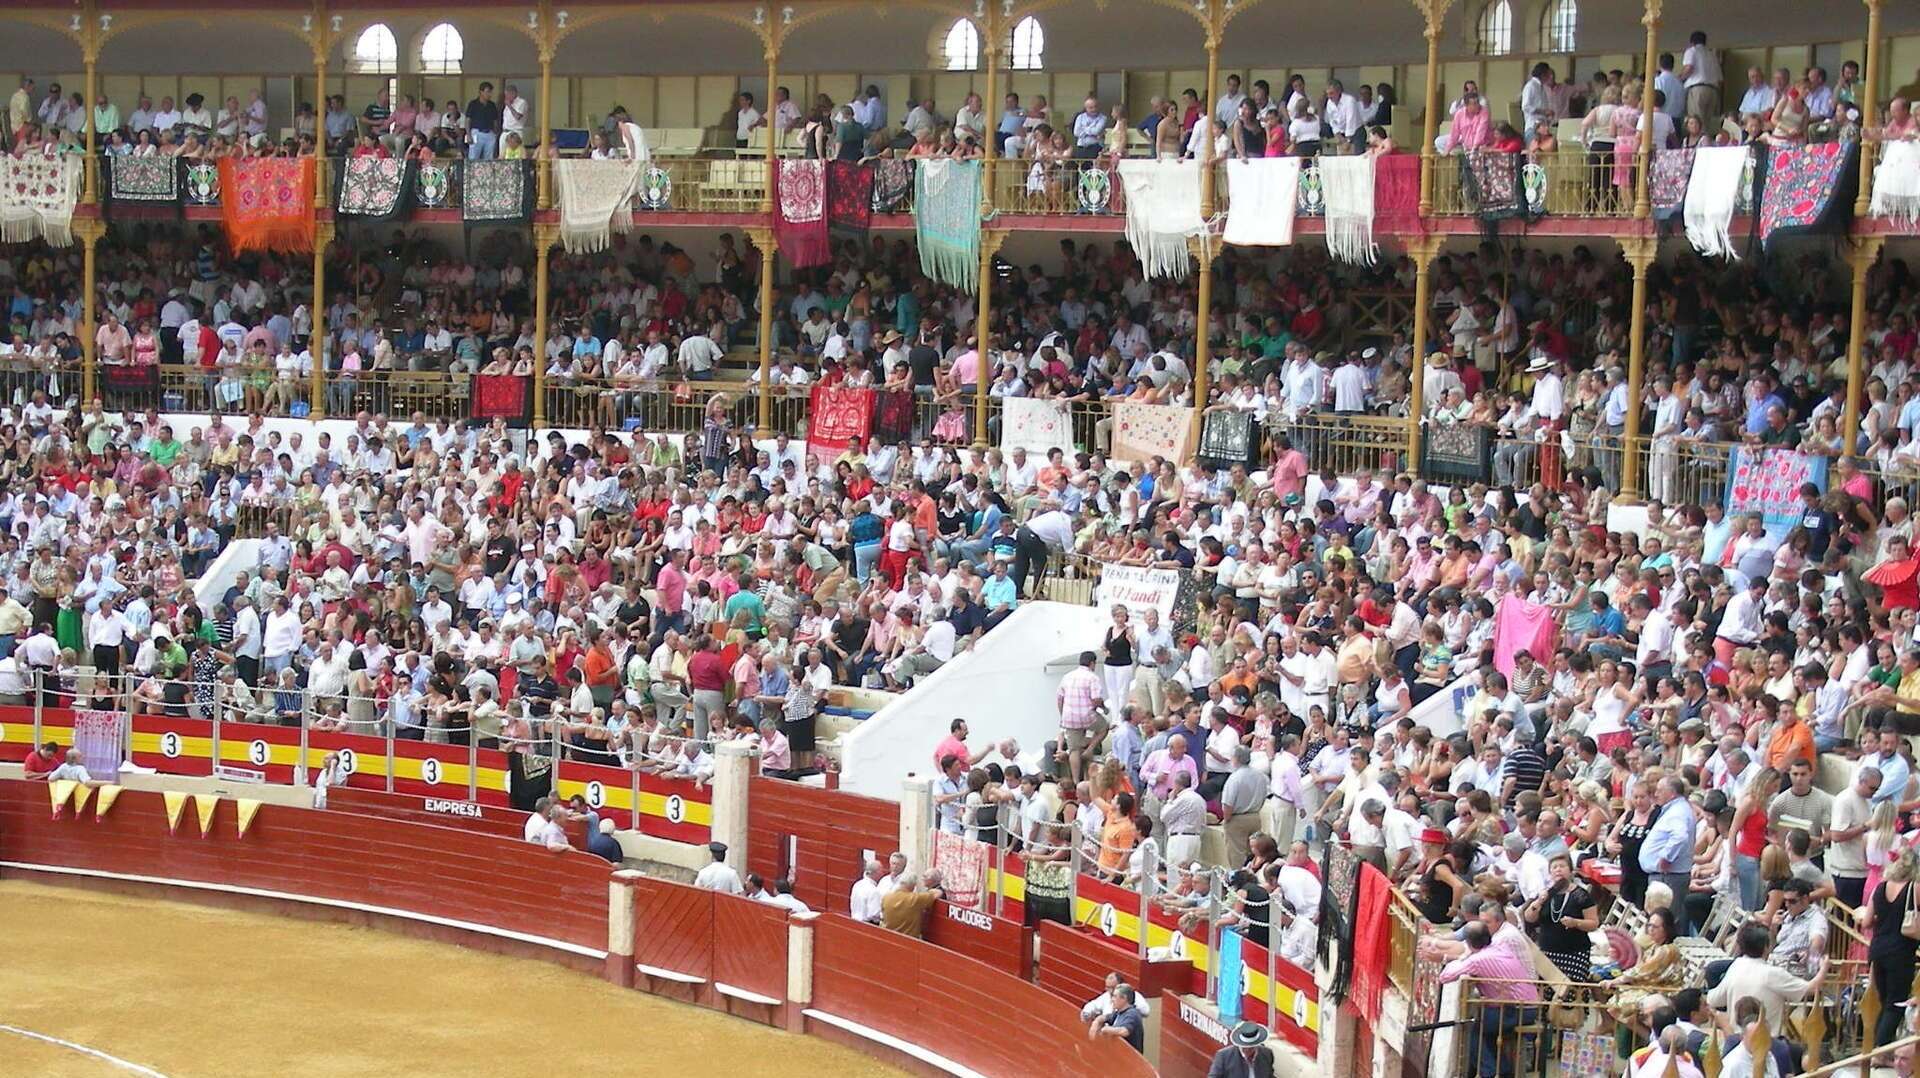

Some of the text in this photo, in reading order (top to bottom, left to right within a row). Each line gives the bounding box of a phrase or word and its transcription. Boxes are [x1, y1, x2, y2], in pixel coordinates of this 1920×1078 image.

[166, 734, 177, 756] 3
[255, 741, 265, 763] 3
[343, 750, 352, 772] 3
[427, 760, 437, 782] 3
[591, 783, 600, 806] 3
[425, 799, 483, 817] EMPRESA
[671, 797, 681, 820] 3
[949, 904, 993, 931] PICADORES
[1104, 907, 1113, 933] 4
[1174, 934, 1182, 957] 4
[1296, 993, 1303, 1022] 4
